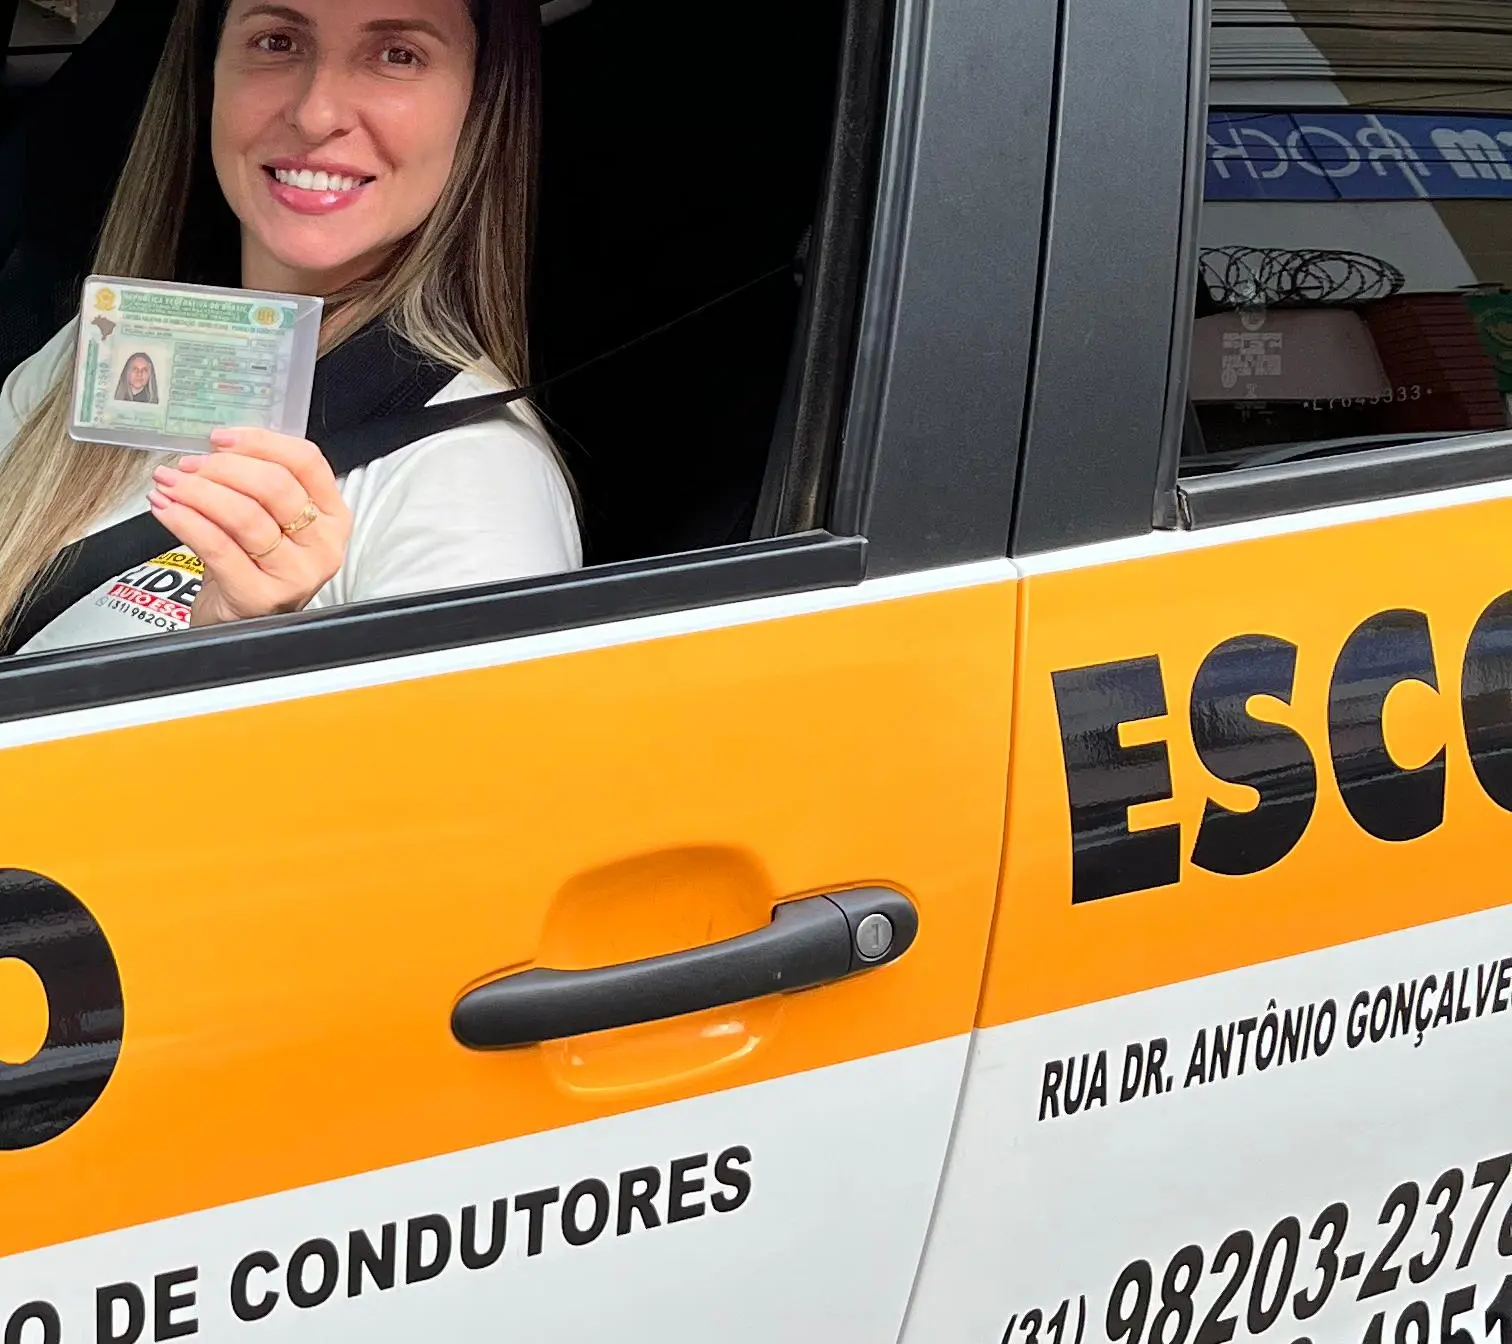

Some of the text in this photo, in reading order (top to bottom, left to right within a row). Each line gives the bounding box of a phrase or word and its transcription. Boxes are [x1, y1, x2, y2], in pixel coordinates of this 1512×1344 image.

[107, 599, 131, 614] (31)
[111, 585, 192, 623] AUTO ESC
[118, 565, 203, 607] LIDE
[1038, 957, 1512, 1122] RUA DR. ANTÔNIO GONÇALVE
[229, 1145, 753, 1322] CONDUTORES
